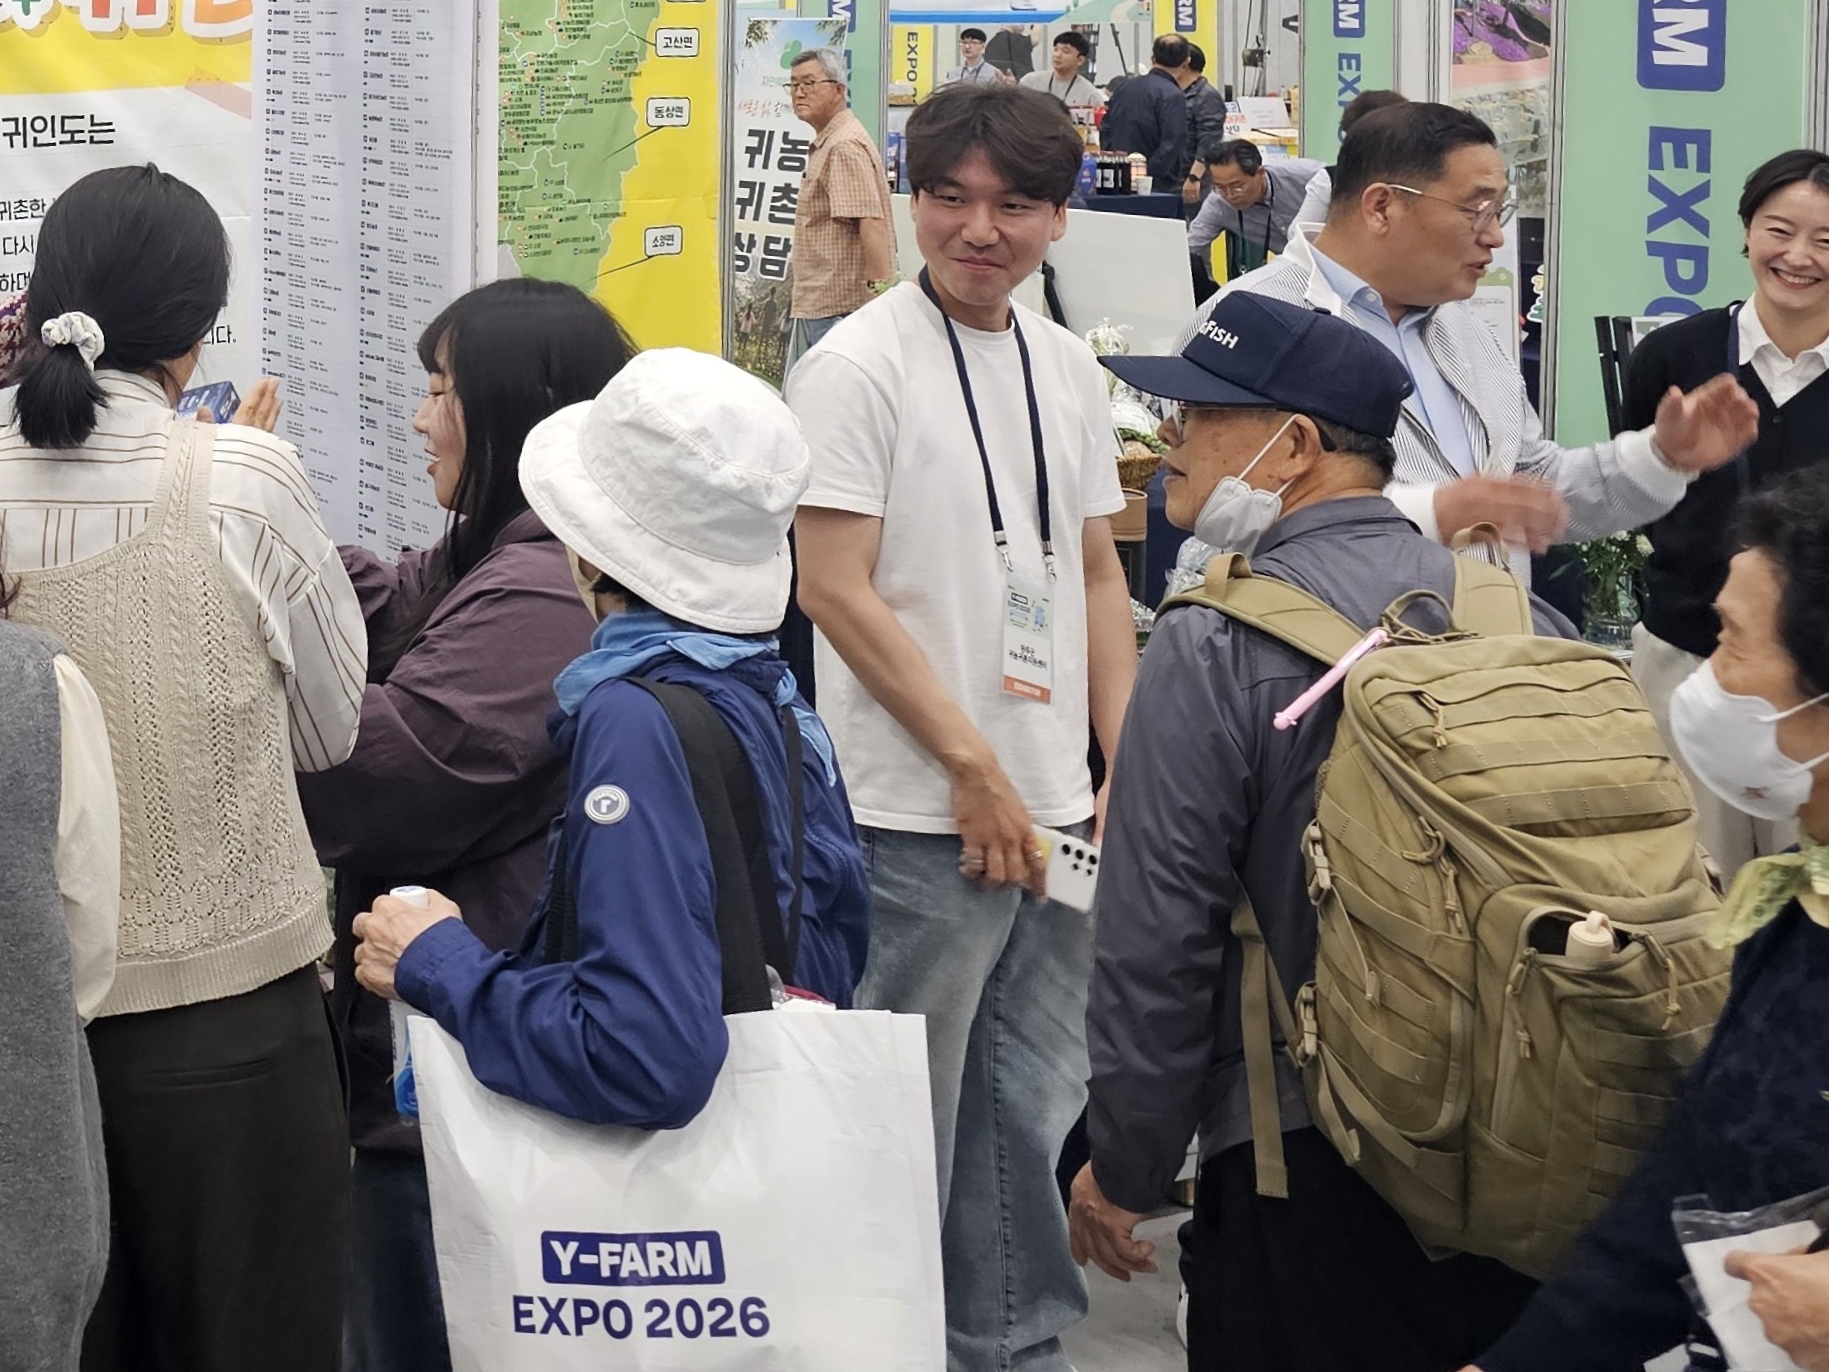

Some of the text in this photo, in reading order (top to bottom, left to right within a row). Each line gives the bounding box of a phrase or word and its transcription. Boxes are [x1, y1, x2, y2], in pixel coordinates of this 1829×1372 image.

[907, 31, 918, 82] EXPO
[3, 114, 116, 149] 귀인도는
[744, 129, 810, 172] 귀농
[2, 236, 35, 256] 다시
[550, 1241, 712, 1278] Y-FARM
[513, 1295, 770, 1339] EXPO 2026
